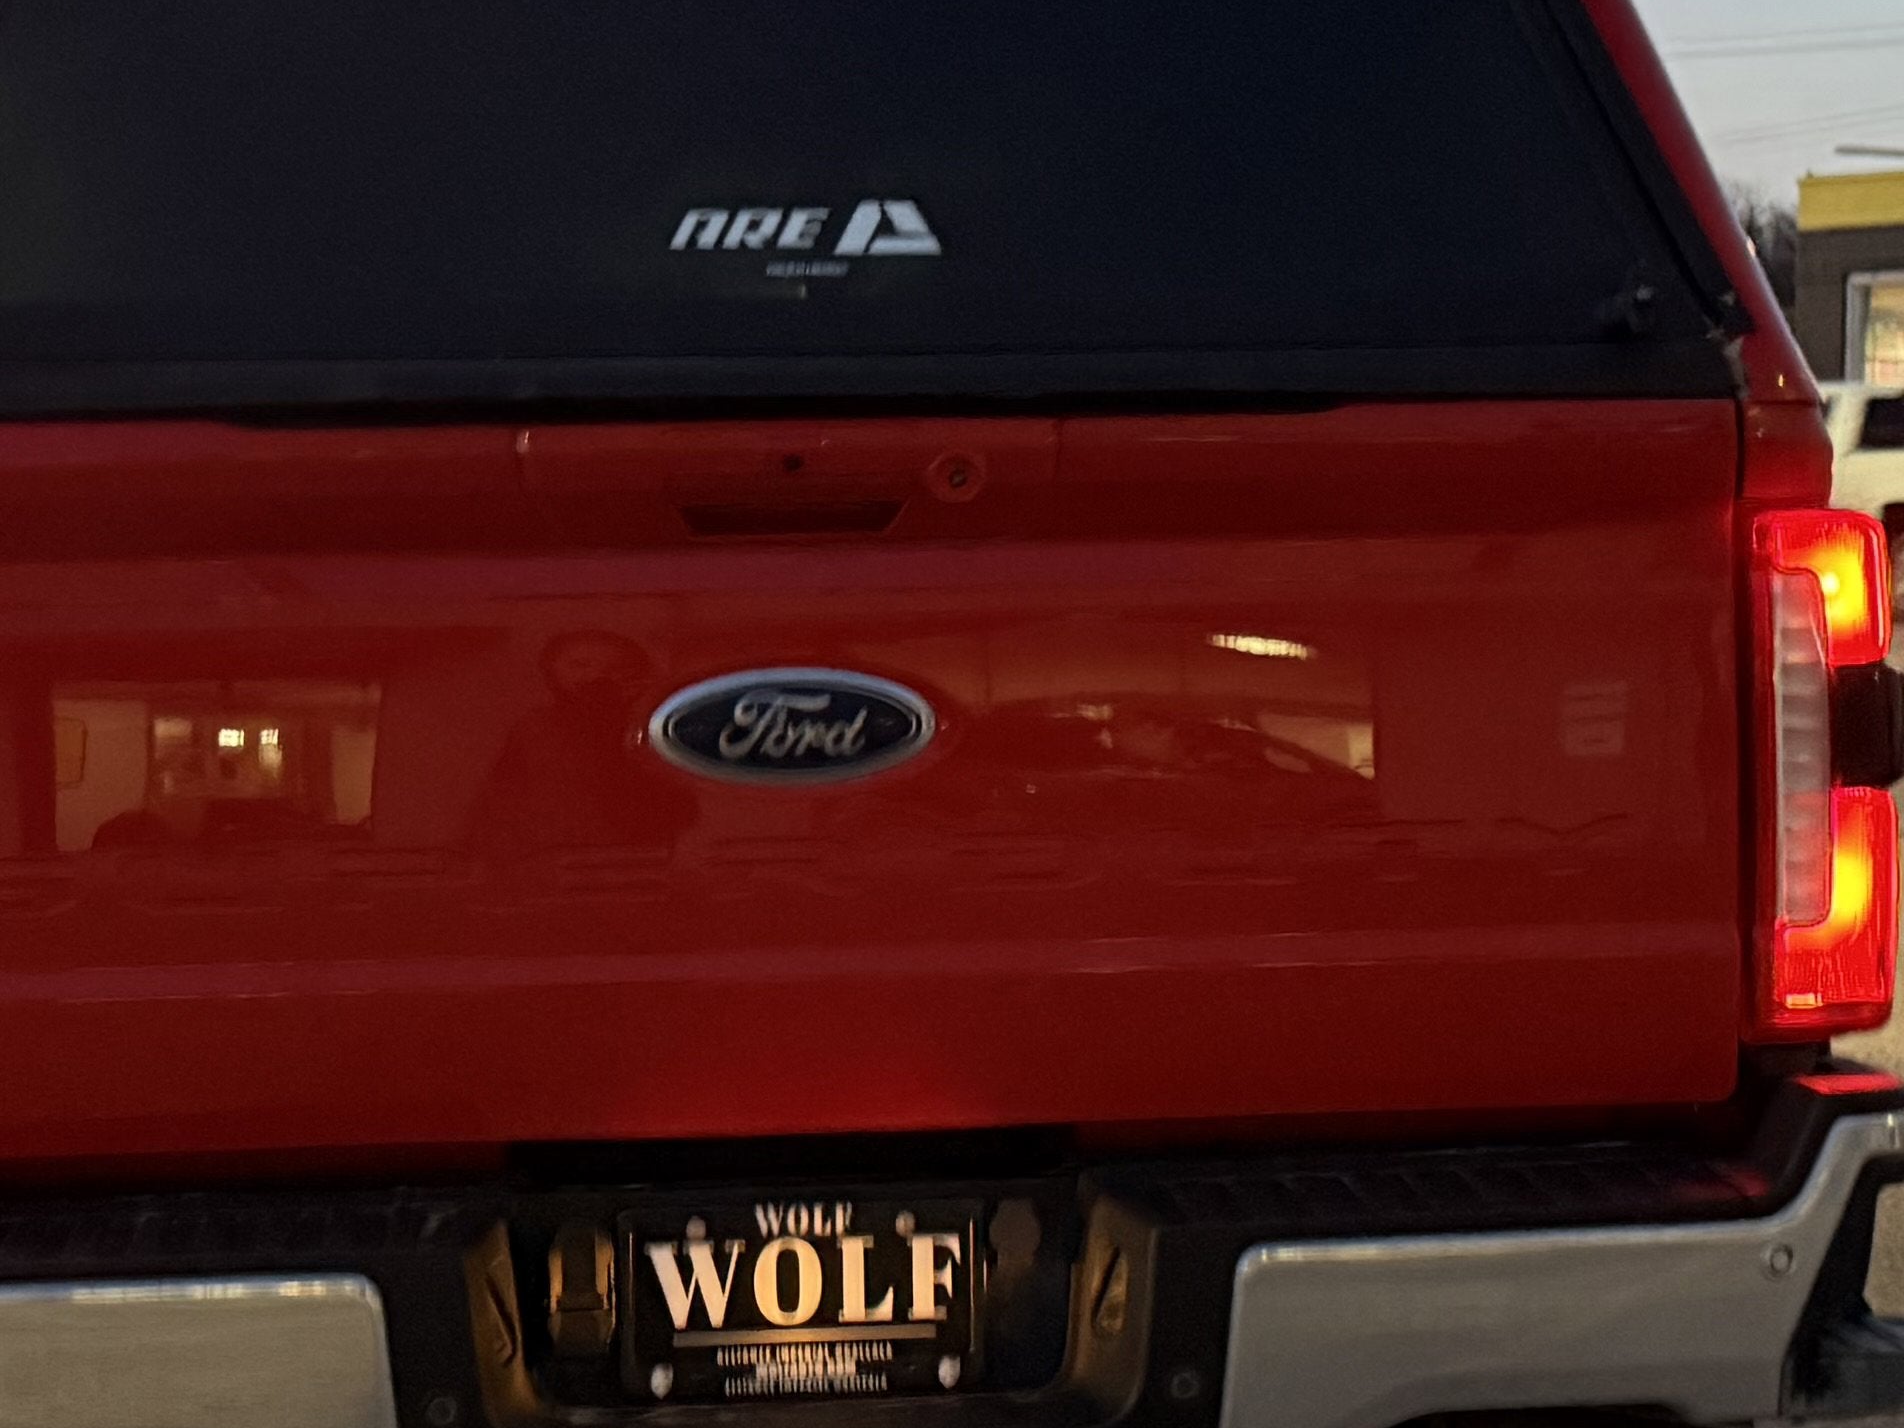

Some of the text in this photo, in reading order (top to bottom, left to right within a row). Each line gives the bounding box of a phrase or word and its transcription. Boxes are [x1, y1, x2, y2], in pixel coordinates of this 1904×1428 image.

[718, 689, 869, 759] Ford
[754, 1201, 853, 1237] WOLF
[644, 1232, 963, 1330] WOLF
